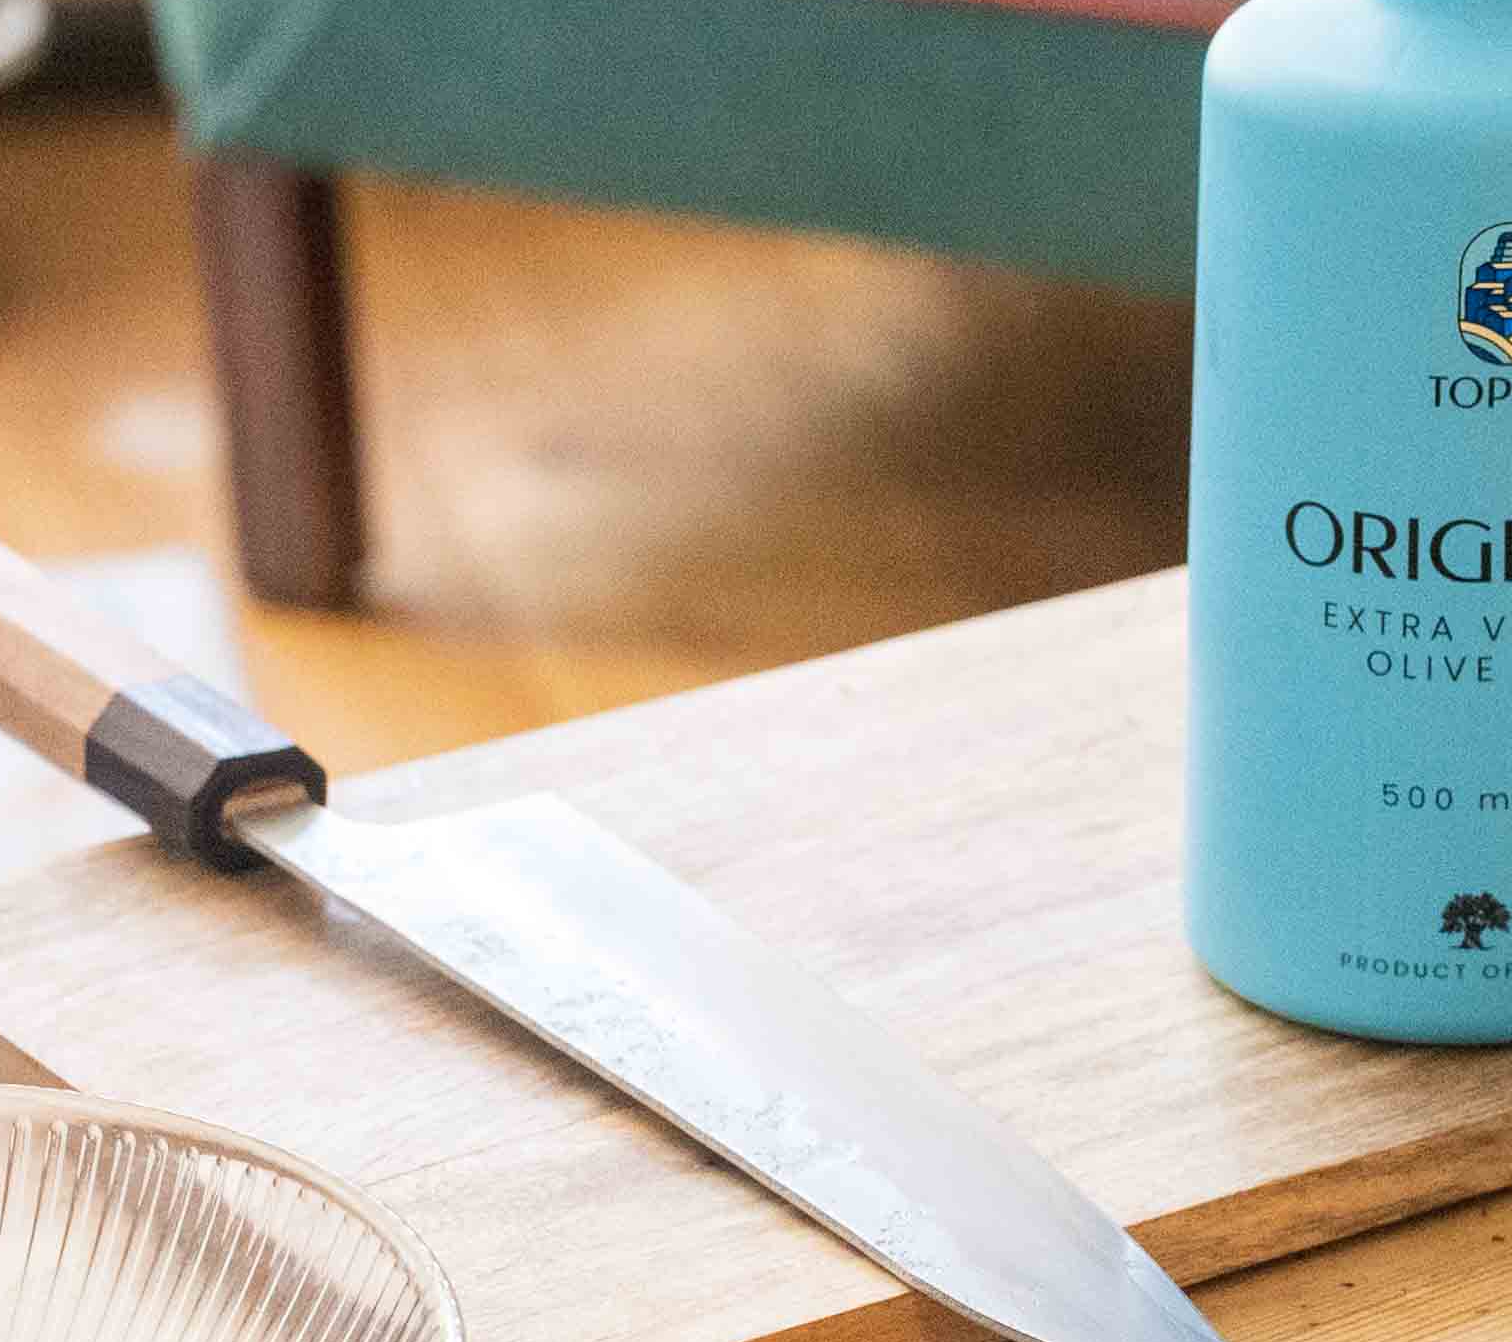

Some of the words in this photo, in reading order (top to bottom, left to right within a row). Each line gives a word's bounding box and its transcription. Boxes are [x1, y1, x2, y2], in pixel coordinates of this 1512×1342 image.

[1323, 601, 1453, 641] EXTRA
[1366, 650, 1493, 682] OLIVE
[1382, 783, 1454, 811] 500
[1340, 952, 1465, 980] PRODUCT
